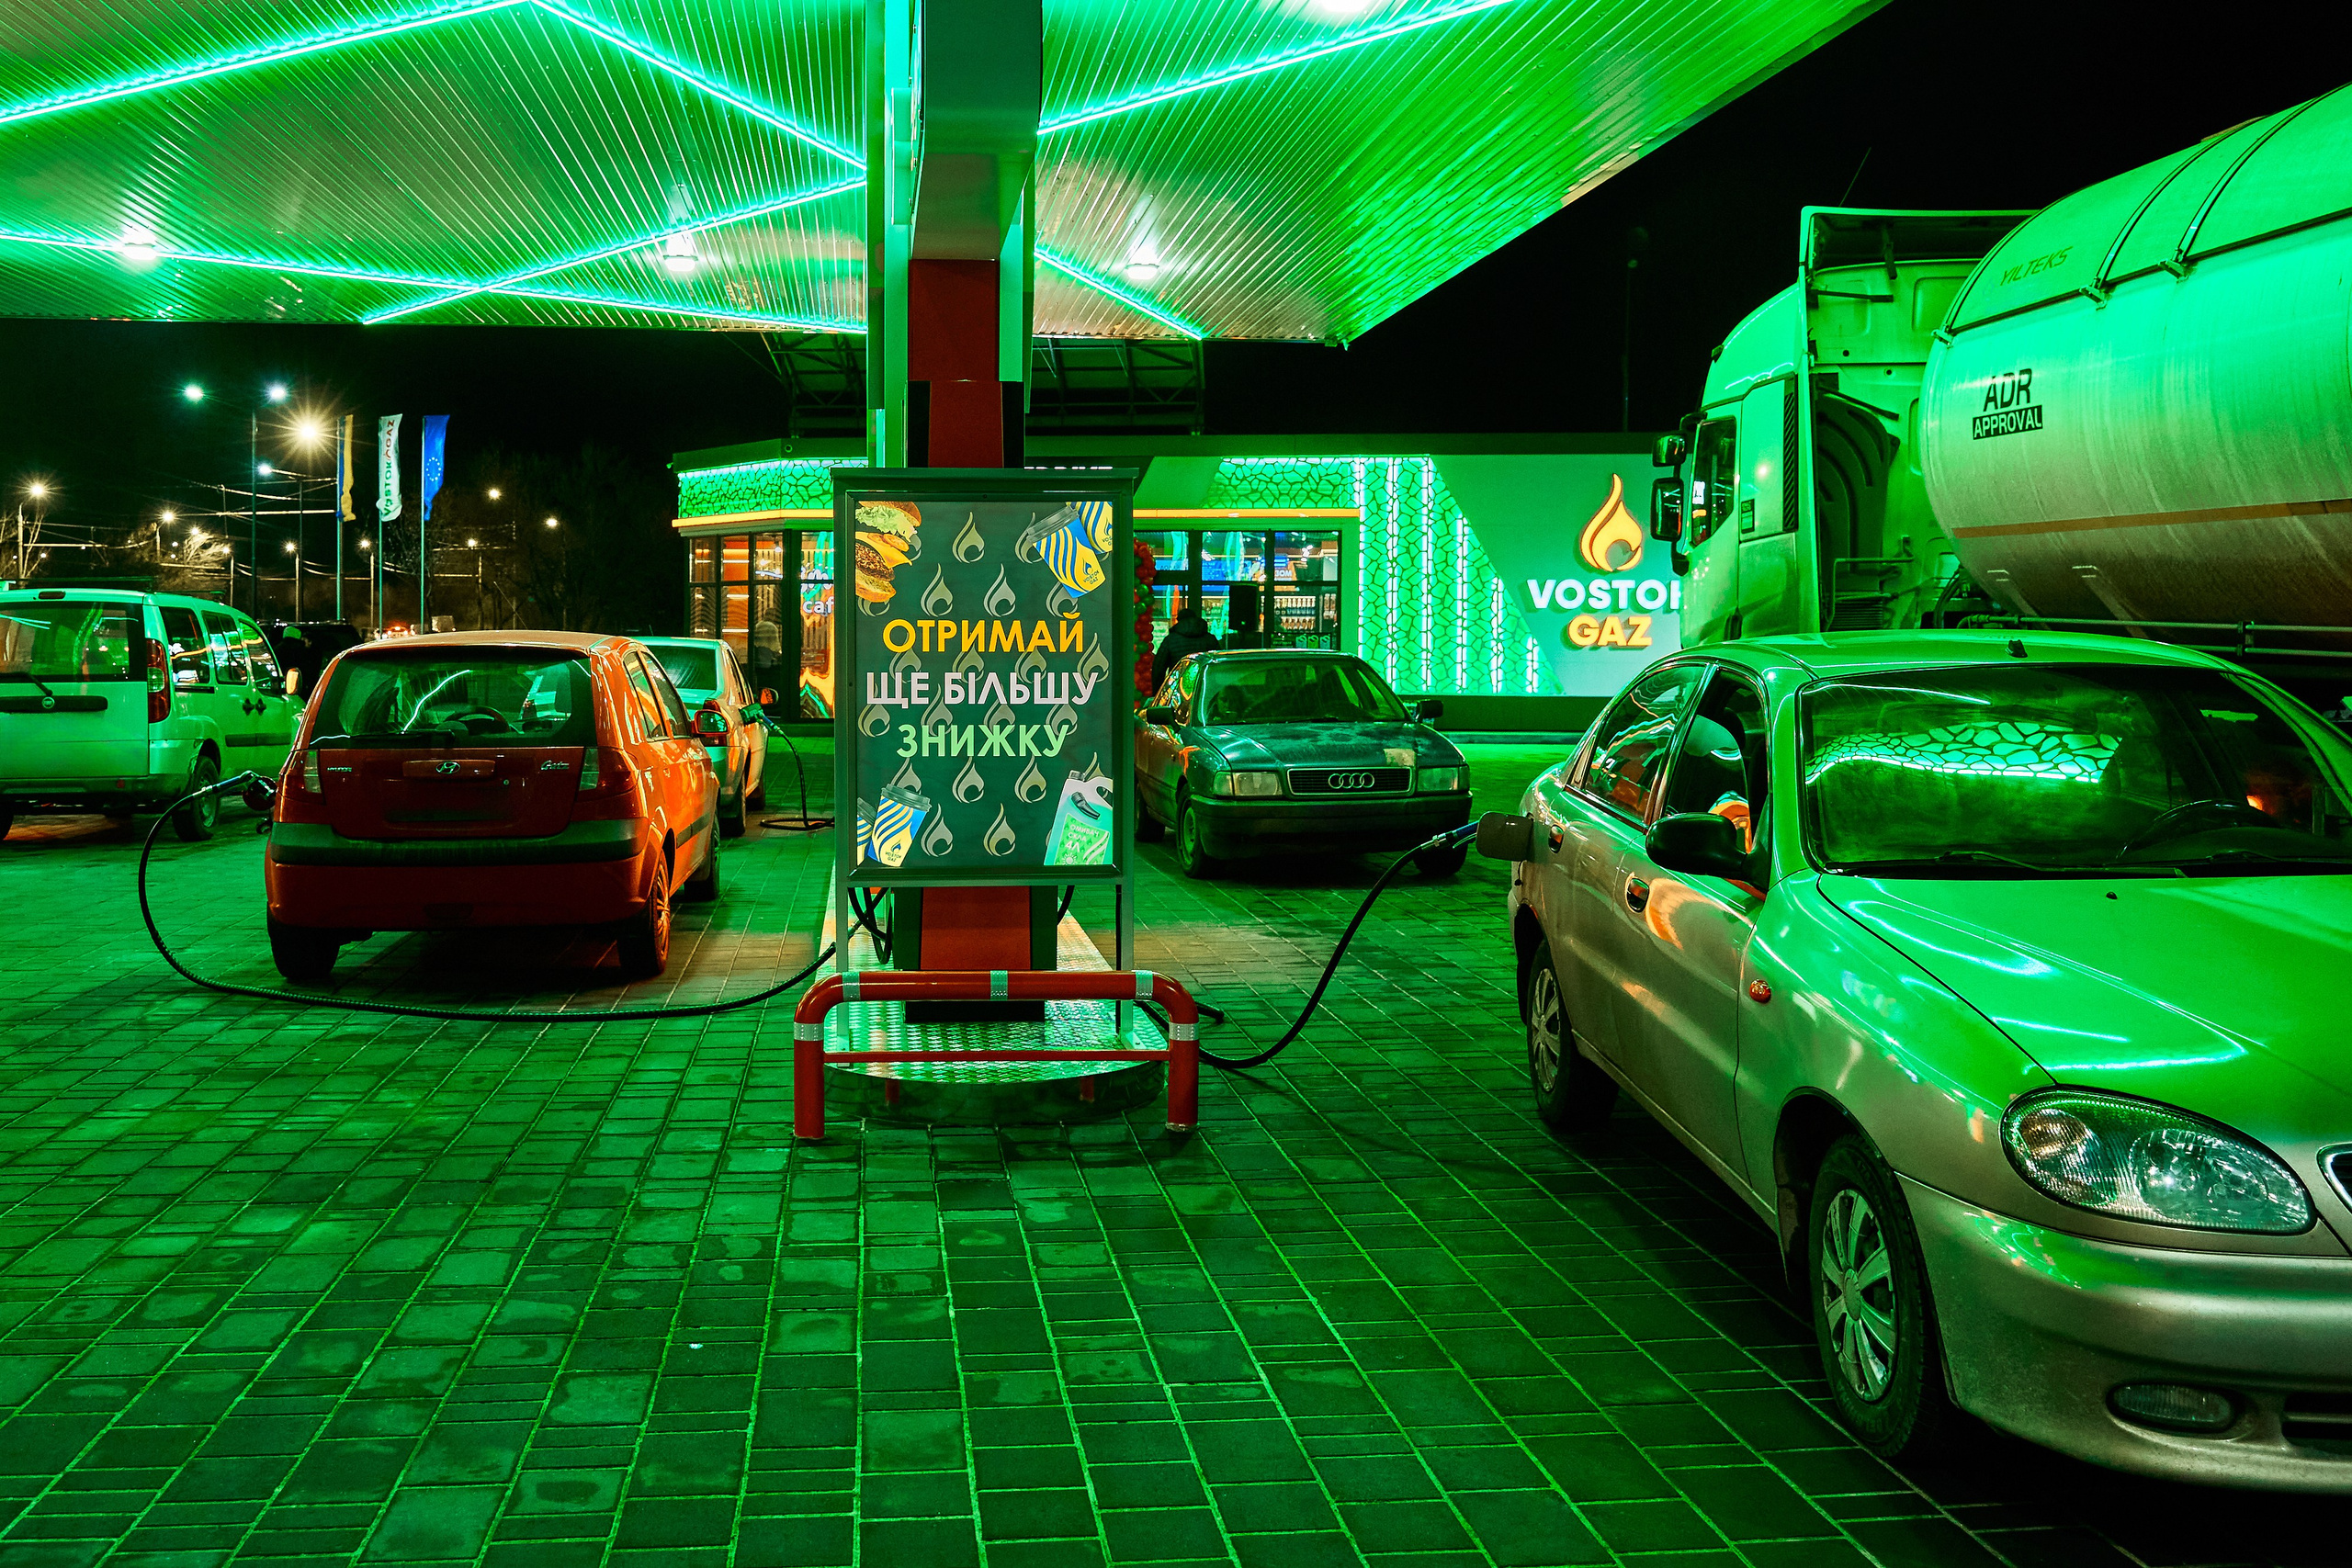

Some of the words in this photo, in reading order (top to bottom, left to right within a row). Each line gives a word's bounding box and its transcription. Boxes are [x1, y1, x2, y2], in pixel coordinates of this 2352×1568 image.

[2000, 245, 2074, 287] YILTEKS
[1983, 368, 2032, 412] ADR
[1973, 408, 2041, 438] APPROVAL
[883, 612, 1084, 653] ОТРИМАЙ
[1567, 614, 1653, 647] GAZ
[866, 671, 930, 709] ЩЕ
[944, 671, 1099, 705] БІЛЬШУ
[897, 724, 1069, 758] ЗНИЖКУ
[1067, 840, 1080, 853] 4Л
[1069, 831, 1087, 841] СКЛА
[1070, 824, 1100, 838] ОМИВАЧ
